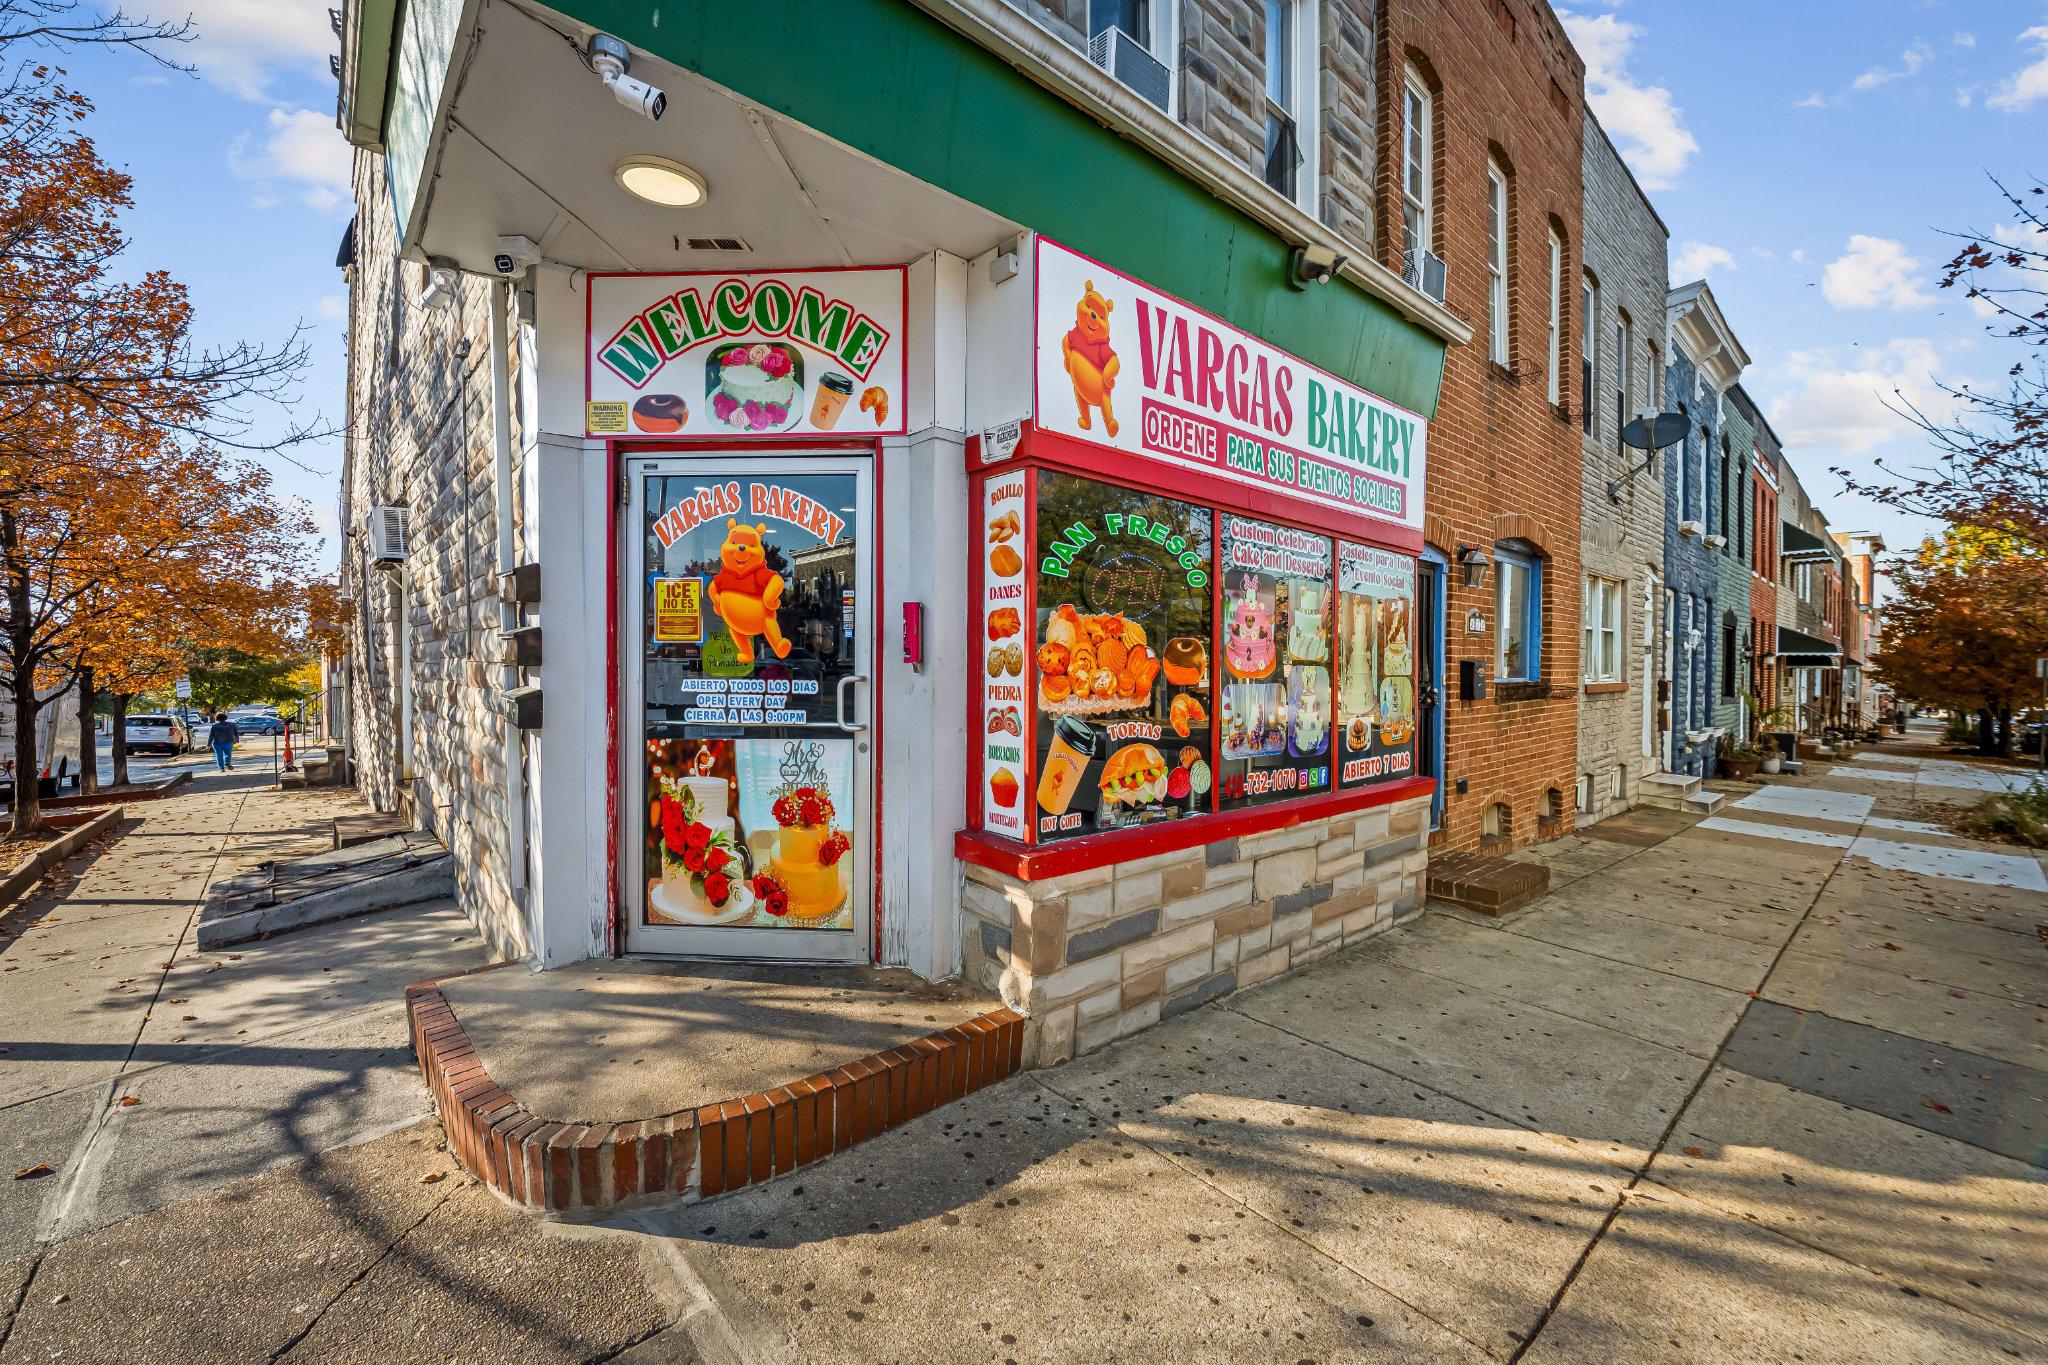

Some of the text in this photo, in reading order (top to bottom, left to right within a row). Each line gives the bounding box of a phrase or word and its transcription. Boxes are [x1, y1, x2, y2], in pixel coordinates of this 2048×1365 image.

[600, 281, 888, 388] WELCOME
[1135, 298, 1415, 479] VARGAS BAKERY
[1145, 407, 1402, 514] ORDENE PARA SUS EVENTOS SOCIALES
[991, 484, 1023, 506] BOLILLO
[652, 481, 845, 549] VARGAS BAKERY
[1231, 520, 1324, 555] Custom Celebrate
[1042, 514, 1207, 587] PAN FRESCO
[1233, 543, 1325, 577] Cake and Desserts
[1340, 543, 1373, 562] Pasteles
[1375, 554, 1393, 567] para
[1092, 569, 1165, 605] OPEN
[1355, 567, 1404, 589] Evento Social
[666, 582, 692, 599] ICE
[990, 584, 1021, 600] DANES
[663, 599, 695, 609] NO ES
[682, 680, 817, 694] ABIERTO TODOS LOS DIAS
[988, 685, 1021, 701] PIEDRA
[697, 695, 786, 708] OPEN EVERY DAY
[685, 709, 805, 723] CIERRA A LAS 9:00PM
[1108, 723, 1161, 740] TORTAS
[1344, 752, 1410, 780] ABIERTO 7 DIAS
[1224, 768, 1296, 798] 410-732-1070
[1041, 813, 1081, 832] HOT COFFE
